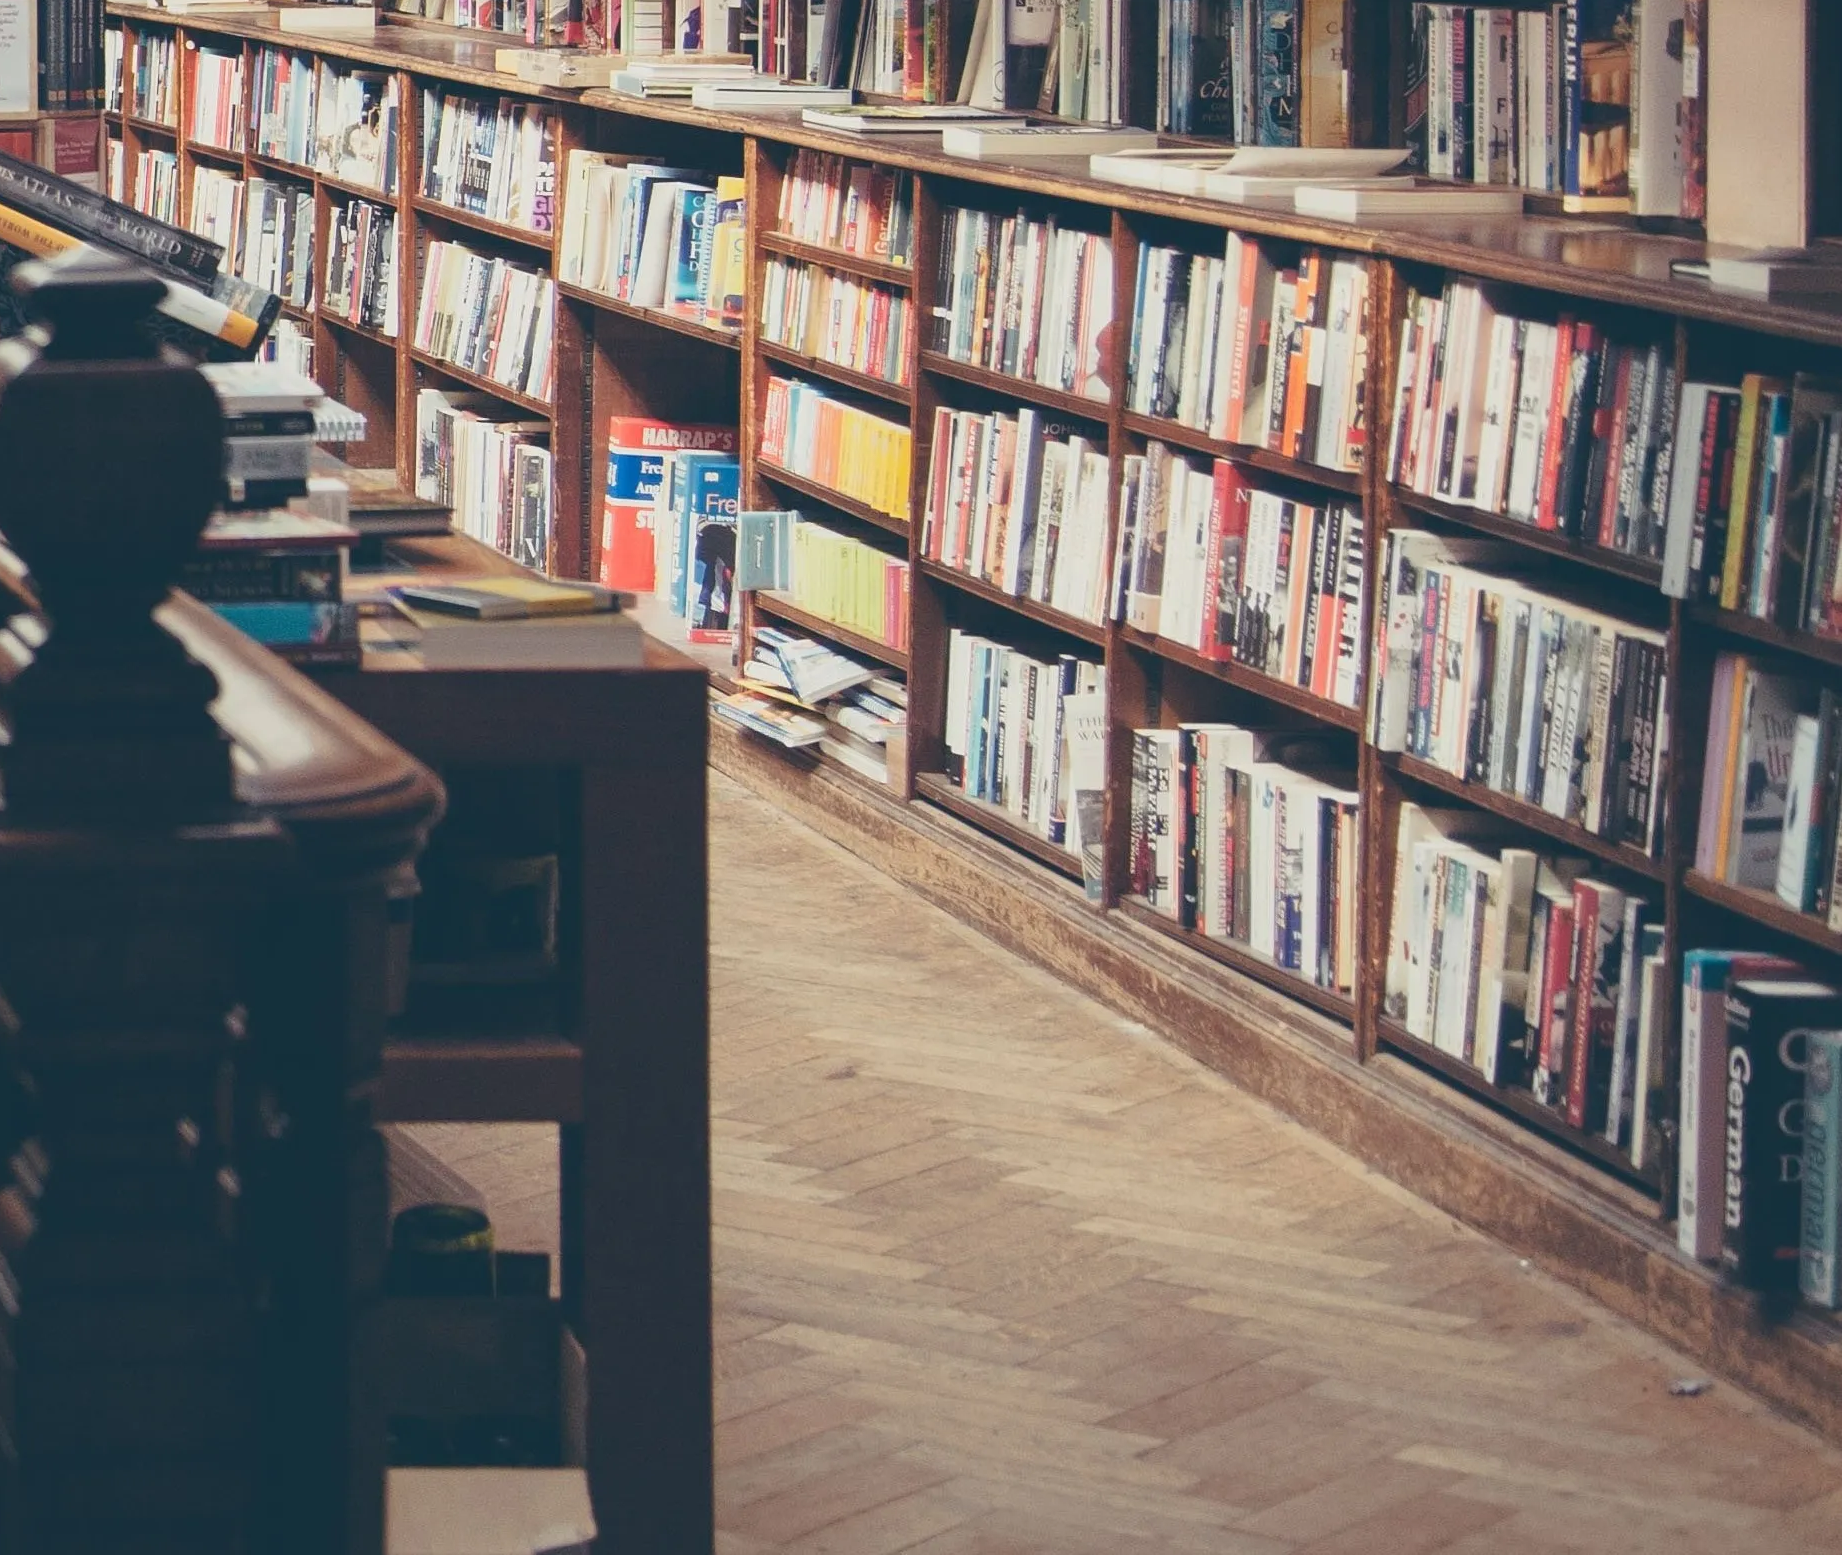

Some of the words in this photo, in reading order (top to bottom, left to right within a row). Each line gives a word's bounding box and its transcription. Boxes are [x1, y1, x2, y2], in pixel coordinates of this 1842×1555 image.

[20, 176, 75, 209] ATLAS
[115, 218, 182, 257] WORLD
[1229, 305, 1251, 401] Bismarck
[643, 427, 733, 450] HARRAP'S
[1043, 424, 1080, 435] JOHN
[1207, 497, 1220, 574] NUREMBERG
[1312, 524, 1325, 587] ADOLF
[1203, 575, 1215, 621] TRIALS
[1629, 715, 1643, 781] DEATH
[1638, 721, 1653, 786] DEATH
[1579, 914, 1596, 985] ORDERLY
[1577, 987, 1592, 1024] AND
[1571, 1025, 1589, 1093] HUMANE
[1686, 1070, 1696, 1131] German
[1724, 1046, 1752, 1228] German
